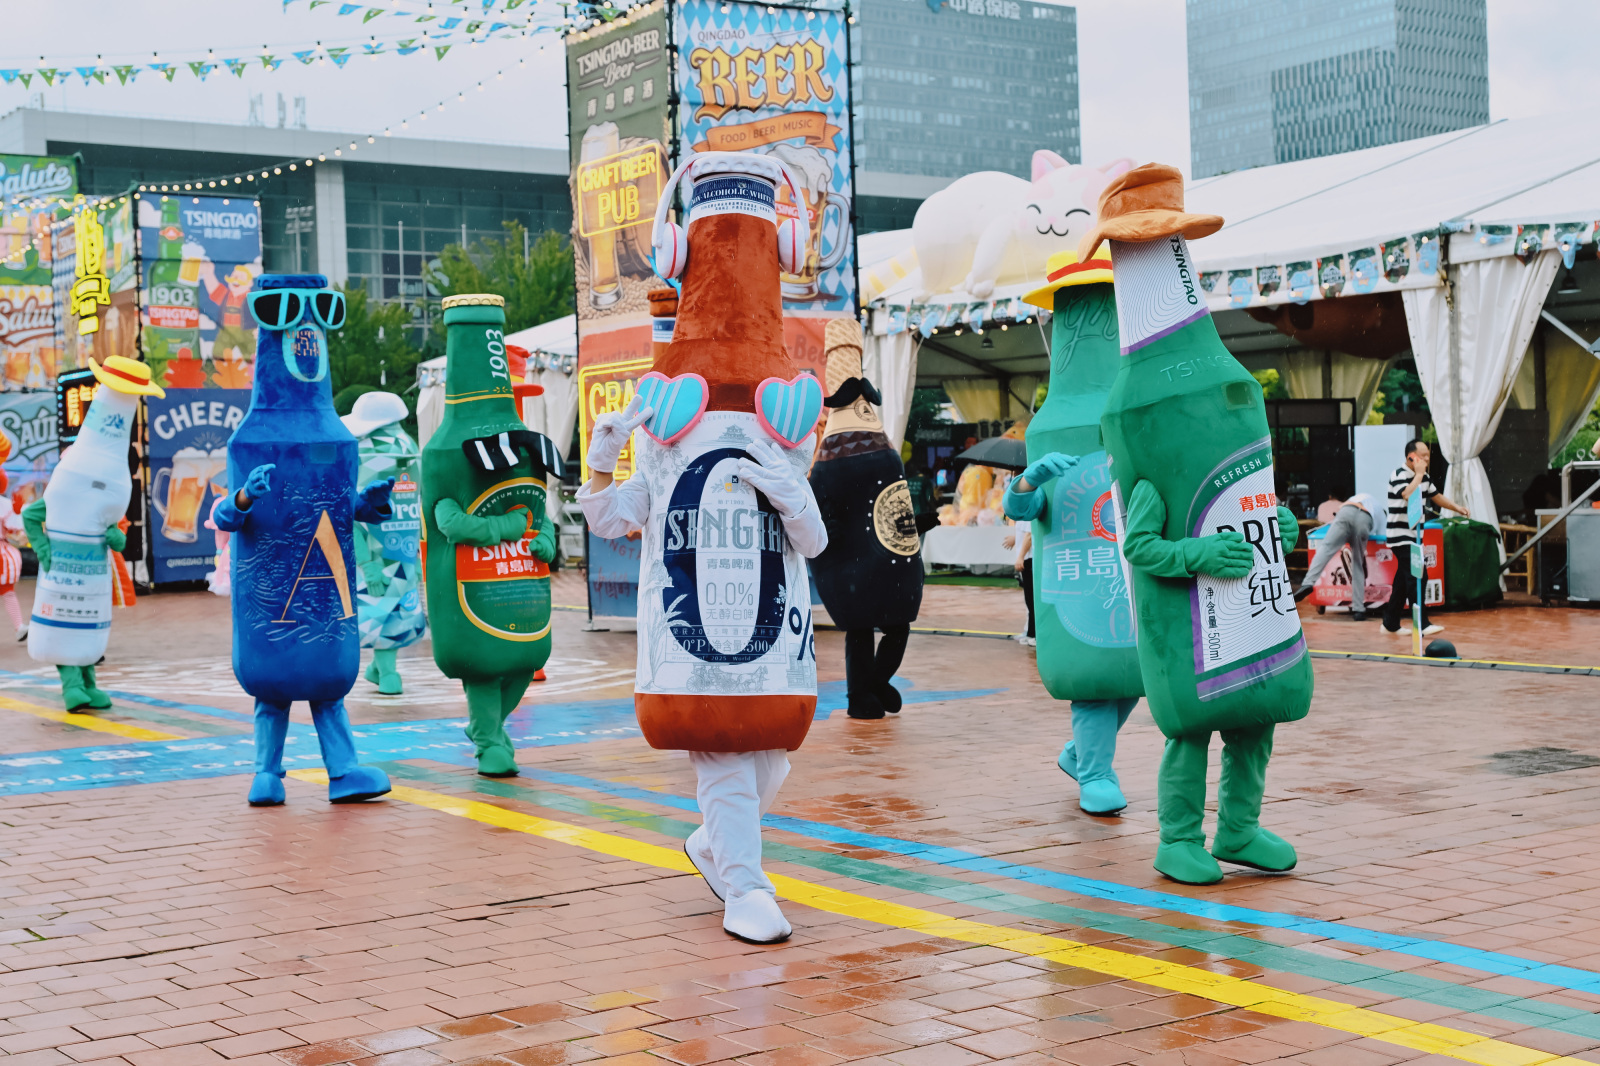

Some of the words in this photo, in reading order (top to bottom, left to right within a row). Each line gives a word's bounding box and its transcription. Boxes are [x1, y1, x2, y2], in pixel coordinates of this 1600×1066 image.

[697, 29, 746, 42] QINGDAO
[576, 29, 660, 76] TSINGTAO-BEER
[603, 62, 635, 88] Beer
[690, 37, 834, 123] BEER
[720, 132, 747, 145] FOOD
[753, 125, 776, 139] BEER
[783, 119, 813, 132] MUSIC
[580, 162, 621, 192] CRAFT
[621, 152, 656, 182] BEER
[183, 210, 258, 229] TSINGTAO
[598, 185, 640, 228] PUB
[1170, 236, 1198, 306] TSINGTAO
[151, 286, 194, 306] 1903
[485, 328, 509, 382] 1903
[1213, 457, 1263, 488] REFRESH
[166, 557, 203, 568] QINGDAO
[271, 509, 357, 623] A
[706, 582, 754, 606] 0.0%
[706, 608, 754, 620] 无醇白啤
